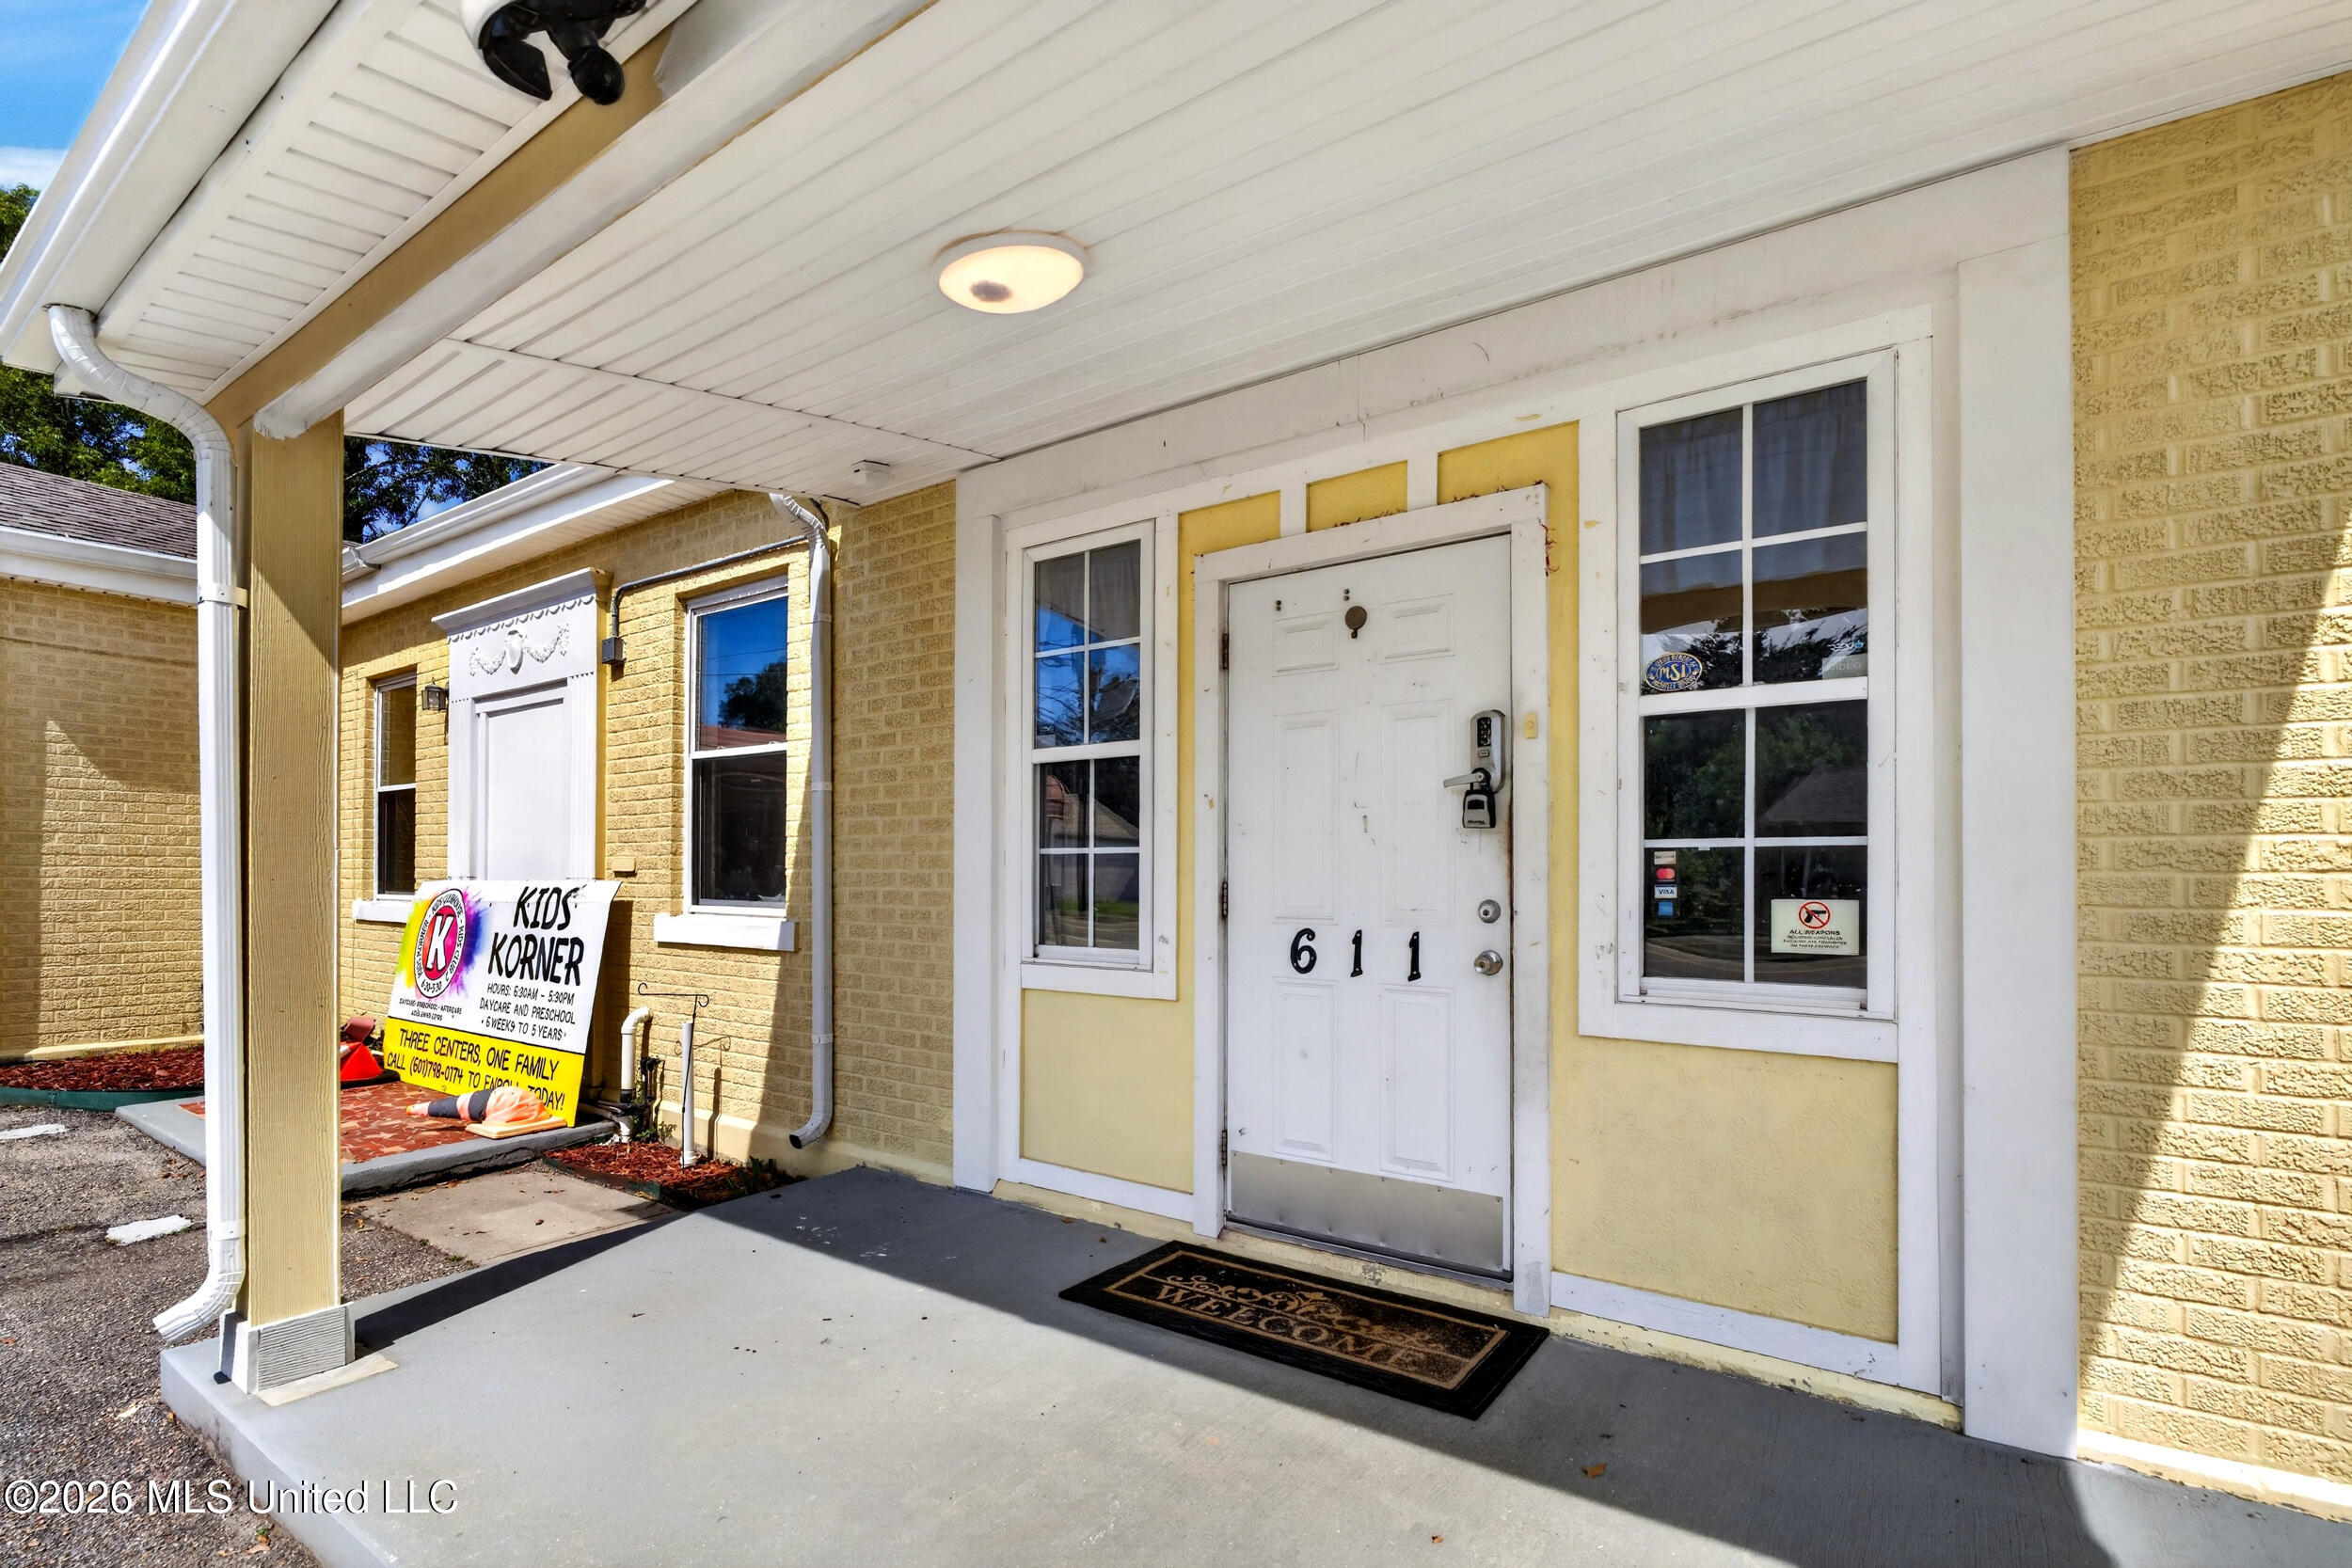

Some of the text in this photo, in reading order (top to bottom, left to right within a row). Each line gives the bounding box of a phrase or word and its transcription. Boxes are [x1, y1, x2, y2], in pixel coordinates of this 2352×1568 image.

[1659, 663, 1686, 682] MSI
[513, 885, 580, 931] KIDS
[425, 911, 456, 972] K
[487, 932, 584, 987] KORNER
[479, 997, 576, 1025] DAYCARE AND PRESCHOOL
[486, 983, 512, 997] HOURS:
[513, 985, 539, 1001] 6:30AM
[548, 990, 575, 1006] 5:30PM
[518, 1022, 529, 1035] TO
[531, 1023, 537, 1037] 5
[538, 1024, 564, 1041] YEARS
[387, 1052, 405, 1070] CALL
[468, 1070, 481, 1088] TO
[400, 1028, 560, 1081] THREE CENTERS, ONE FAMILY
